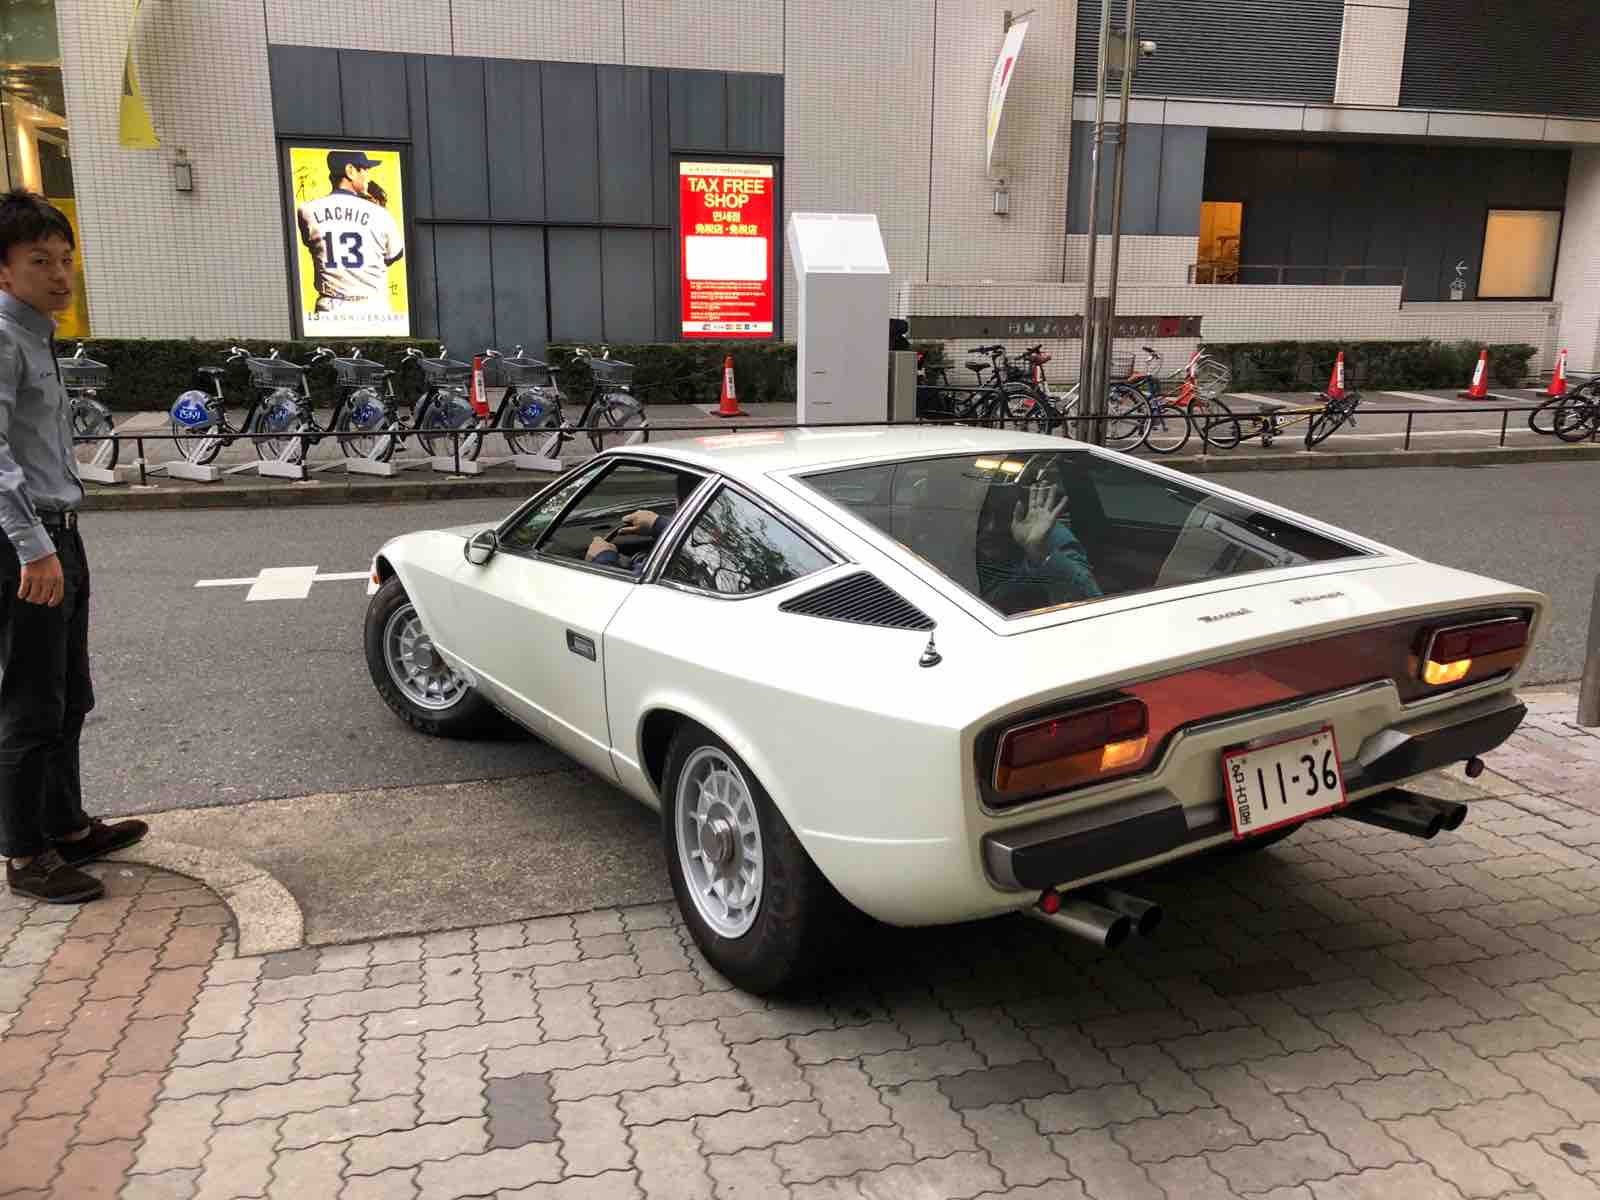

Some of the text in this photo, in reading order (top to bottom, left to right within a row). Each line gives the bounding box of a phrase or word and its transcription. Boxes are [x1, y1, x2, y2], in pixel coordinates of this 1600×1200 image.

[688, 177, 765, 194] TAX FREE
[704, 193, 749, 209] SHOP
[314, 206, 370, 226] LACHIC
[322, 231, 364, 269] 13
[1257, 749, 1337, 810] 11-36
